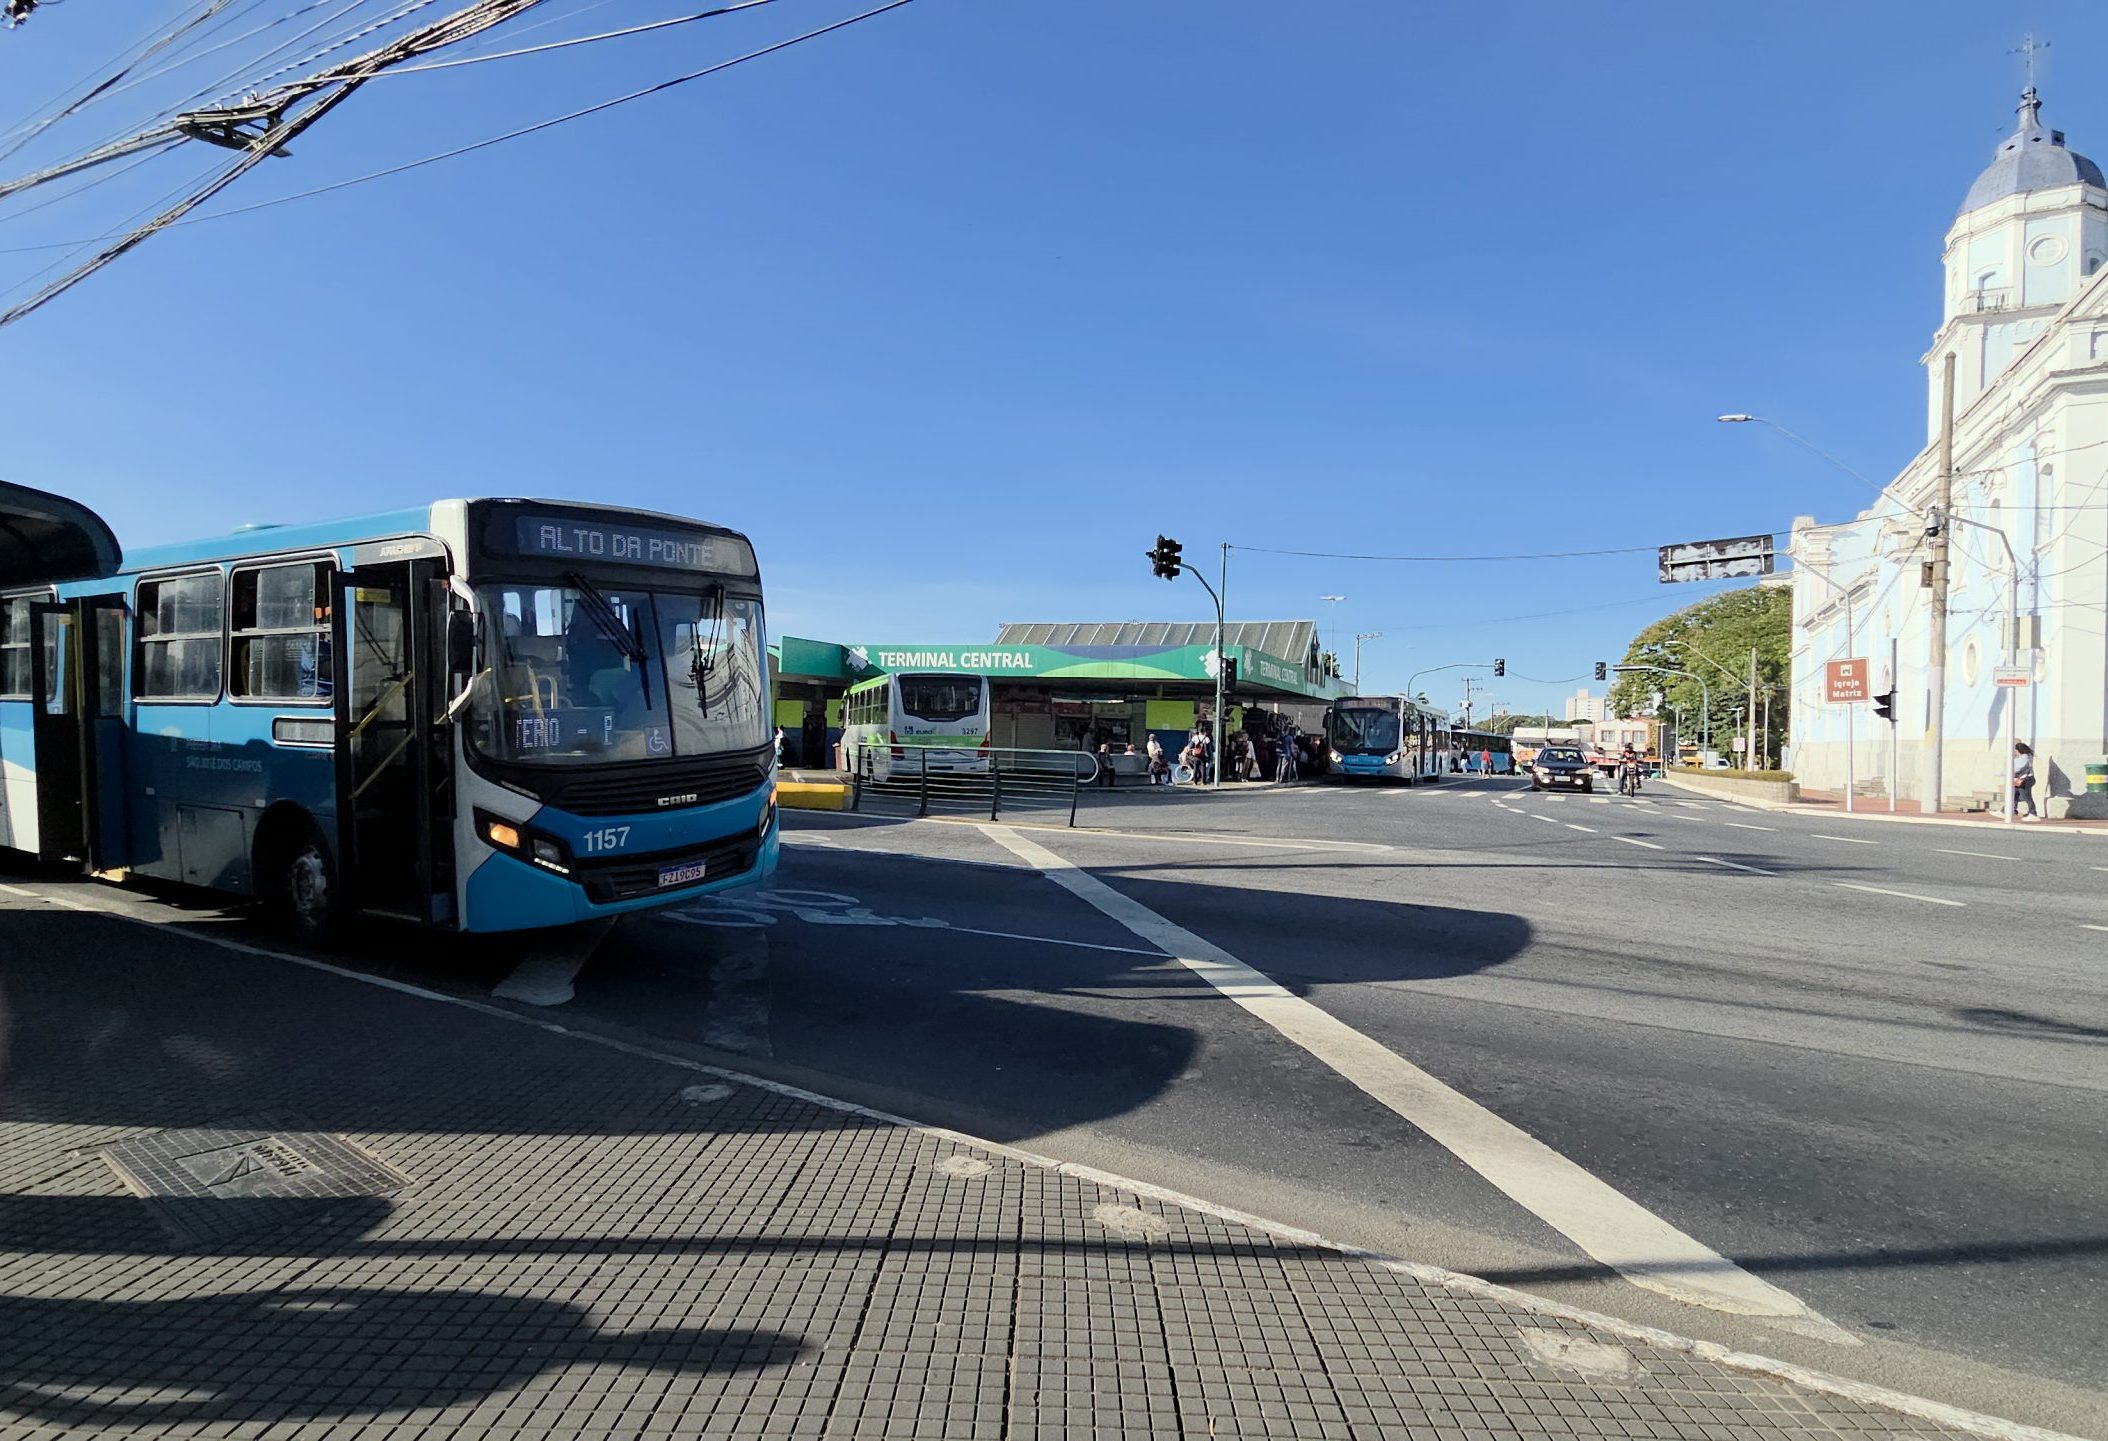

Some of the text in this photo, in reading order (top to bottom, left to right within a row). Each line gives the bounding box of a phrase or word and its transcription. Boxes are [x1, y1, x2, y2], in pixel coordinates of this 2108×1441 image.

[540, 525, 714, 567] ALTO DA PONTE
[878, 651, 1033, 668] TERMINAL CENTRAL
[1833, 679, 1860, 689] Igreja
[1832, 690, 1863, 698] Matriz
[657, 793, 698, 807] CAIO
[583, 826, 631, 852] 1157
